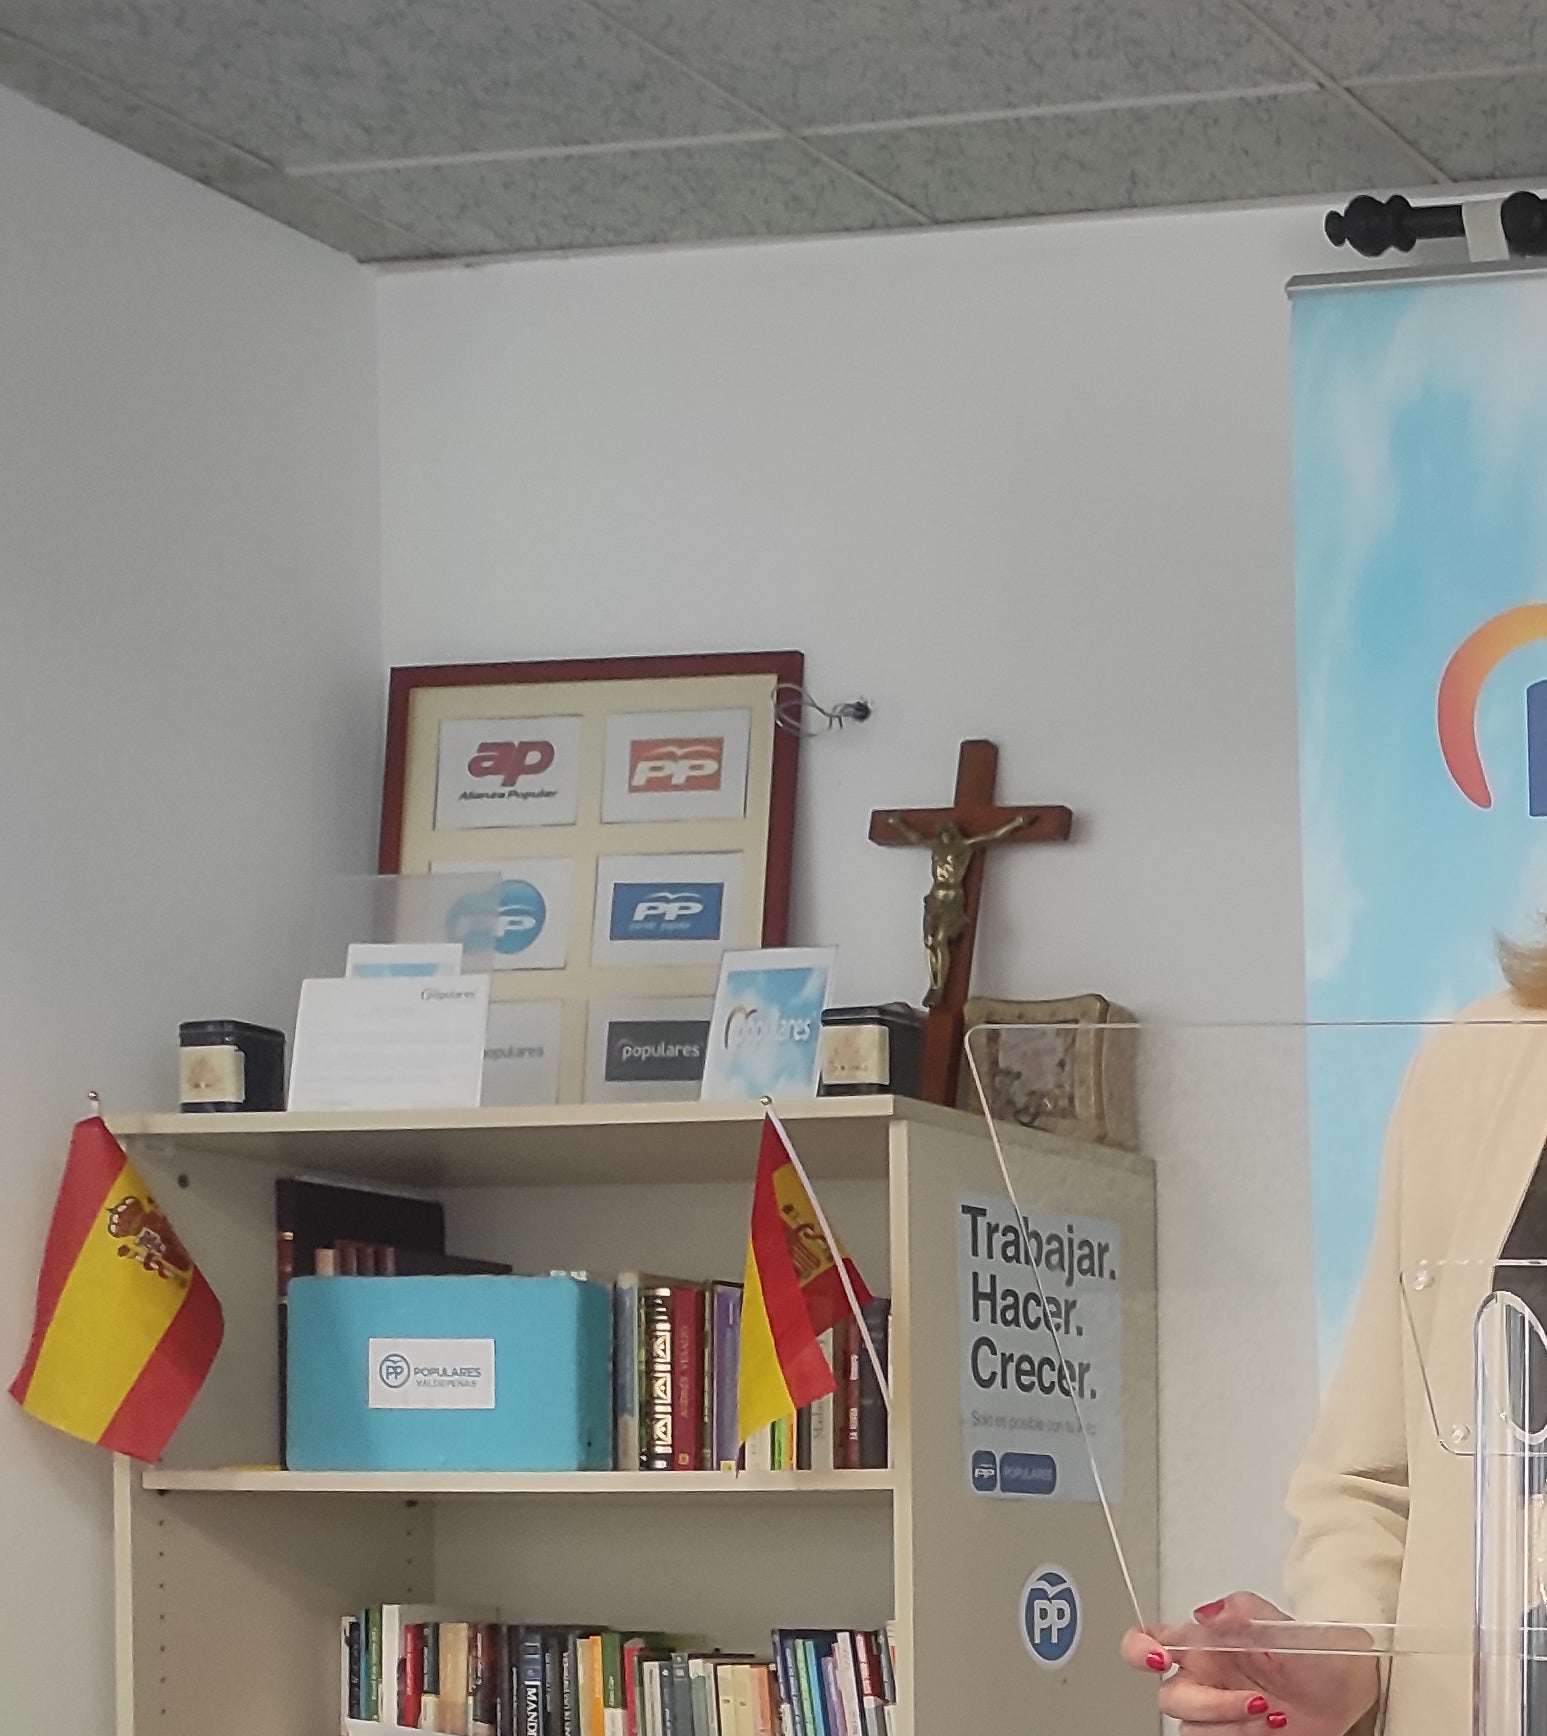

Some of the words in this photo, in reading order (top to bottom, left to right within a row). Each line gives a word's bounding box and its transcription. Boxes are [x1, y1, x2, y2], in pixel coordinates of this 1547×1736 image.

[467, 740, 555, 788] ap
[621, 1042, 700, 1062] populares
[960, 1204, 1118, 1288] Trabajar.
[971, 1271, 1083, 1337] Hacer.
[413, 1367, 482, 1378] POPULARES
[970, 1335, 1097, 1400] Crecer.
